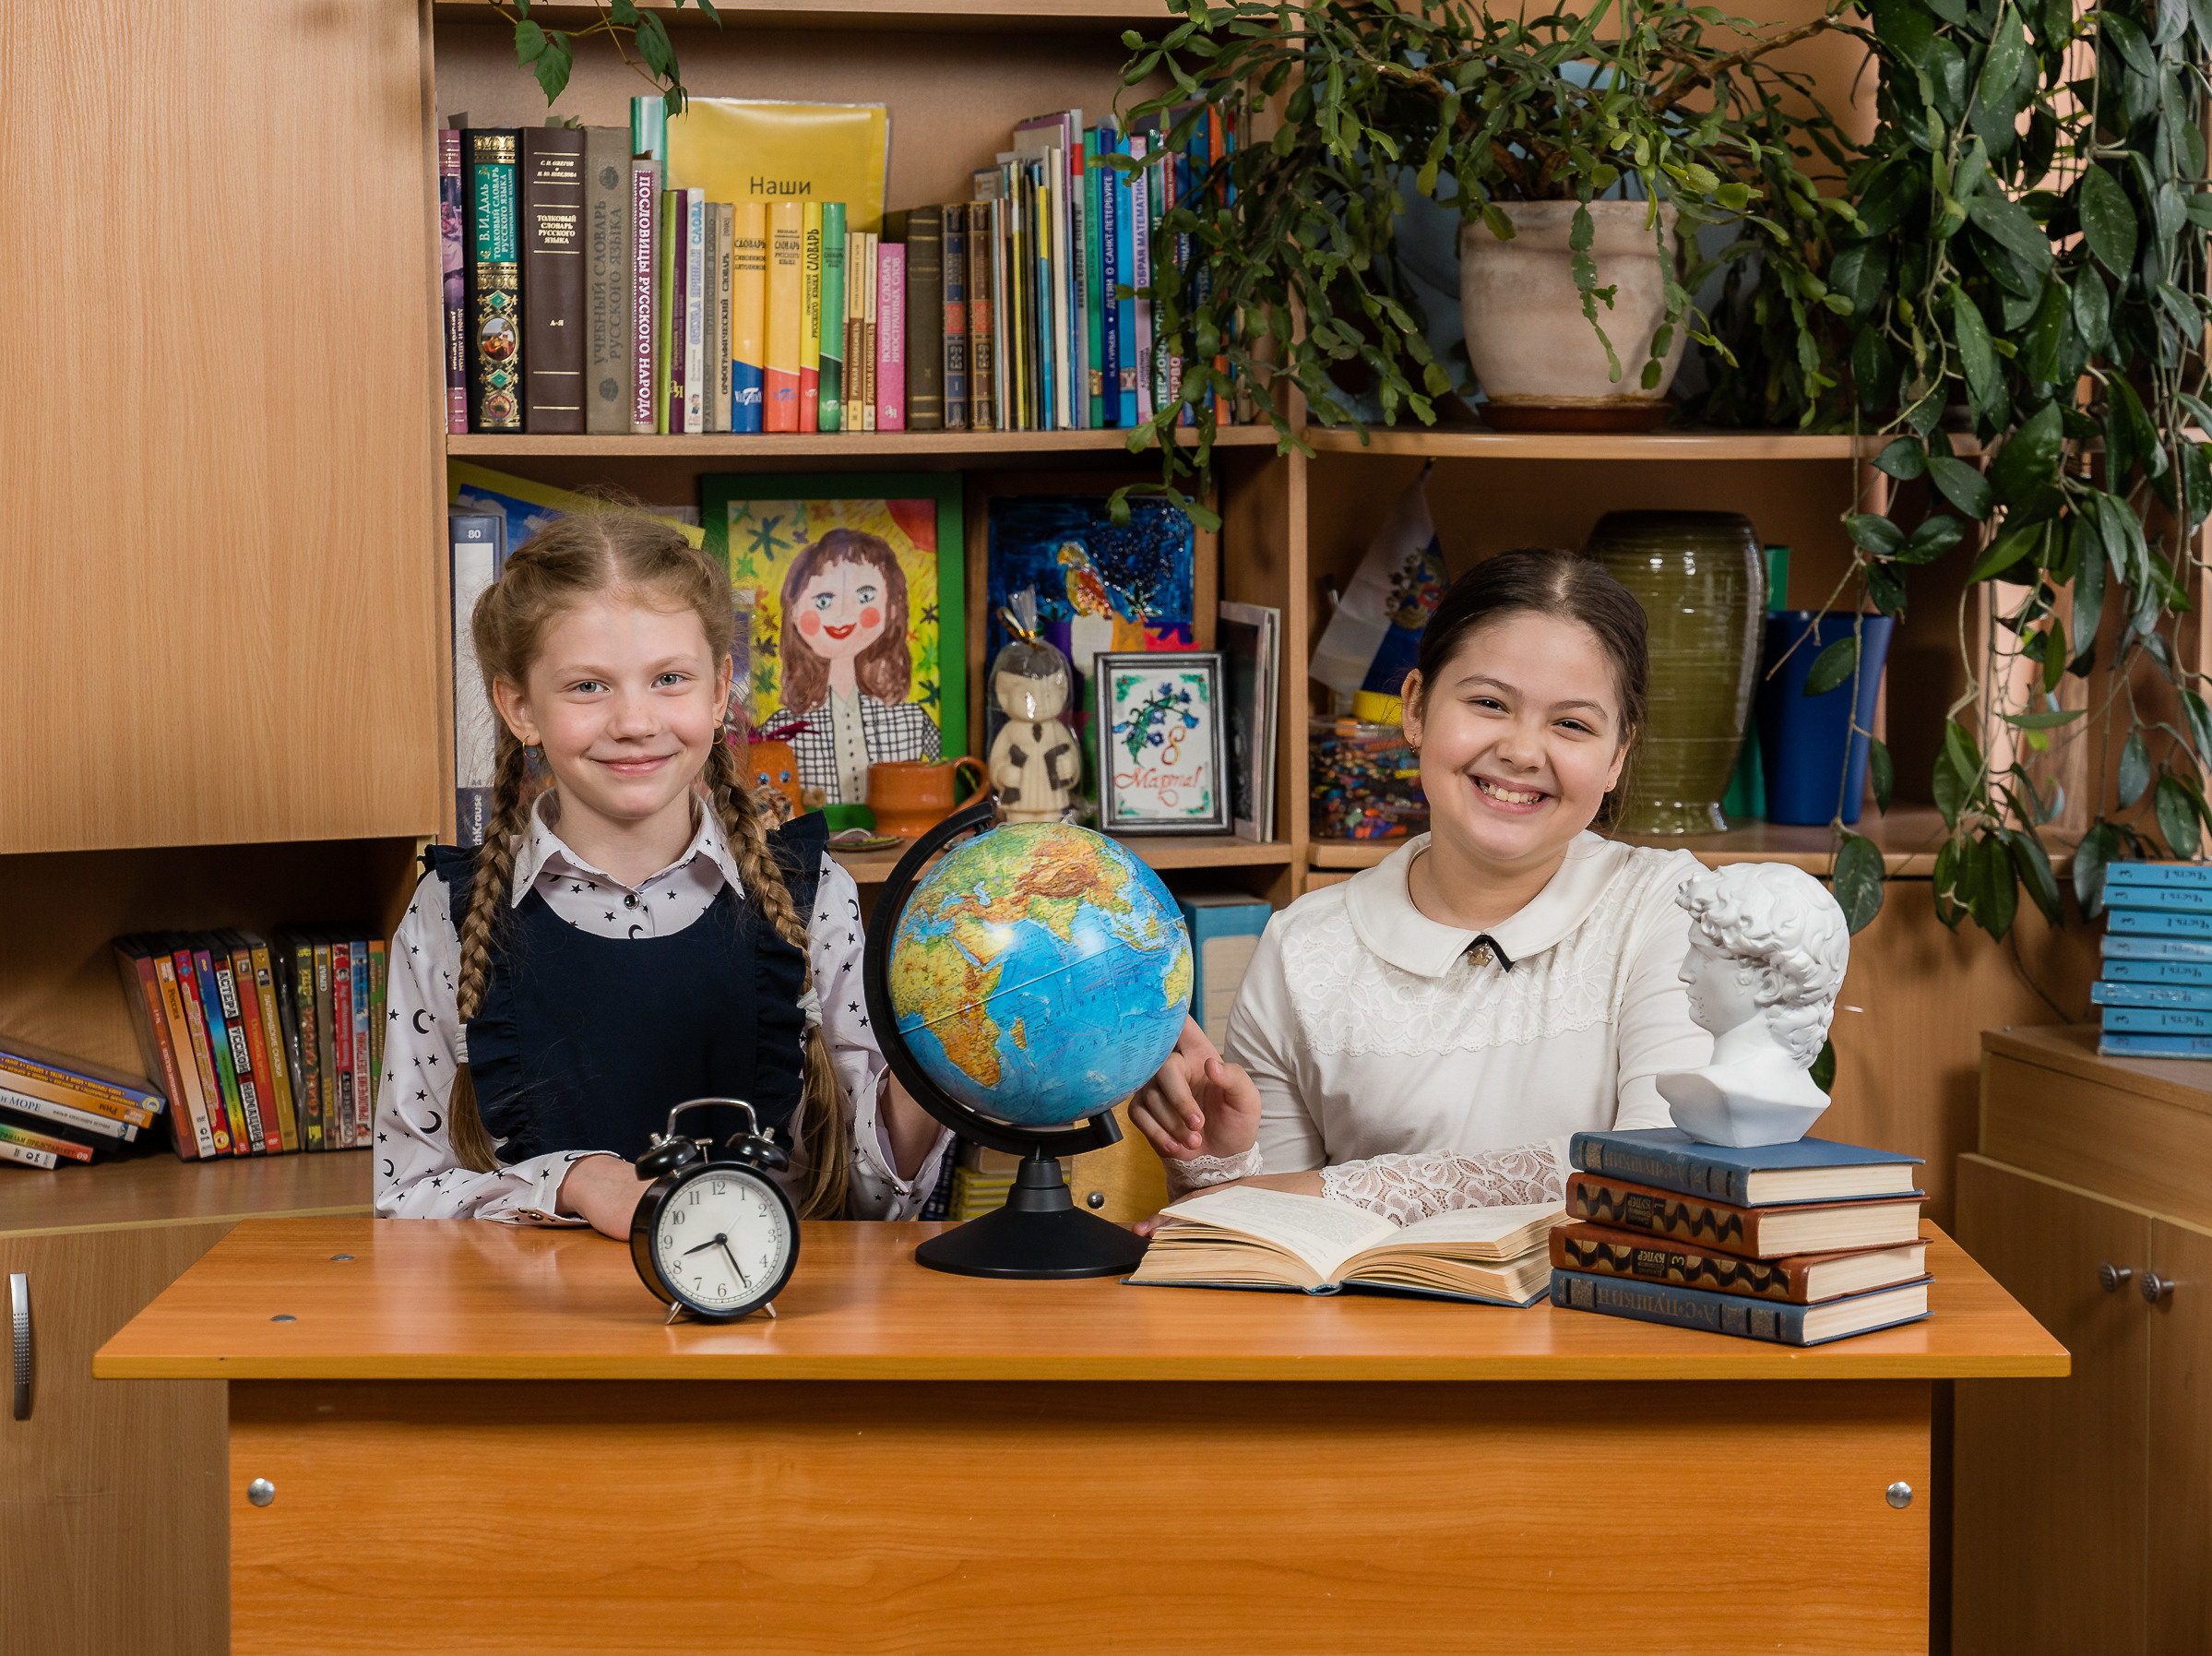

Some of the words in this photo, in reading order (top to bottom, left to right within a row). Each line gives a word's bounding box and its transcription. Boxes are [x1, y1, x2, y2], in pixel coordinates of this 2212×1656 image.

[491, 167, 500, 206] СЛОВАРЬ
[499, 173, 507, 205] ЯЗЫКА
[749, 176, 812, 196] Наши
[479, 215, 491, 229] И.
[492, 208, 501, 259] ТОЛКОВЫЙ
[500, 208, 510, 253] РУССКОГО
[537, 214, 577, 222] ТОЛКОВЫЙ
[637, 176, 651, 273] ПОСЛОВИЦЫ
[690, 200, 702, 244] СЛОВА
[1103, 175, 1115, 265] САНКТ-ПЕТЕРБУРГЕ
[480, 231, 491, 242] В.
[593, 199, 606, 276] СЛОВАРЬ
[609, 207, 622, 266] ЯЗЫКА
[734, 238, 766, 249] СЛОВАРЬ
[806, 228, 820, 271] СЛОВАРЬ
[721, 253, 730, 292] СЛОВАРЬ
[881, 256, 891, 303] СЛОВАРЬ
[891, 256, 901, 286] СЛОВ
[1106, 267, 1115, 276] О
[1136, 249, 1147, 287] ОБРАЯ
[1105, 278, 1116, 310] ДЕТЯМ
[591, 281, 608, 365] УЧЕБНЫЙ
[609, 271, 624, 360] РУССКОГО
[637, 276, 651, 355] РУССКОГО
[890, 288, 900, 363] ИНОСТРАННЫХ
[719, 298, 730, 395] ОРФОГРАФИЧЕСКИЙ
[880, 305, 891, 363] НОВЕЙШИЙ
[636, 357, 651, 419] НАРОДА
[468, 530, 481, 539] 80
[1161, 725, 1186, 766] 8
[1114, 766, 1202, 807] Марта!
[356, 1031, 368, 1075] ЭЛЕКТРОНИКА
[1078, 1020, 1136, 1054] ОКЕАН
[357, 1076, 369, 1122] ПРИКЛЮЧЕНИЯ
[688, 1190, 700, 1205] 11
[712, 1181, 725, 1196] 12
[740, 1186, 745, 1200] 1
[1627, 1196, 1652, 1208] КУПЕР
[672, 1210, 685, 1225] 10
[758, 1203, 767, 1218] 2
[663, 1235, 673, 1249] 9
[767, 1229, 777, 1244] 3
[672, 1260, 683, 1274] 8
[759, 1255, 769, 1269] 4
[1637, 1250, 1666, 1264] КУПЕР
[1671, 1255, 1685, 1265] 3
[694, 1277, 703, 1291] 7
[717, 1283, 727, 1297] 6
[744, 1275, 753, 1289] 5
